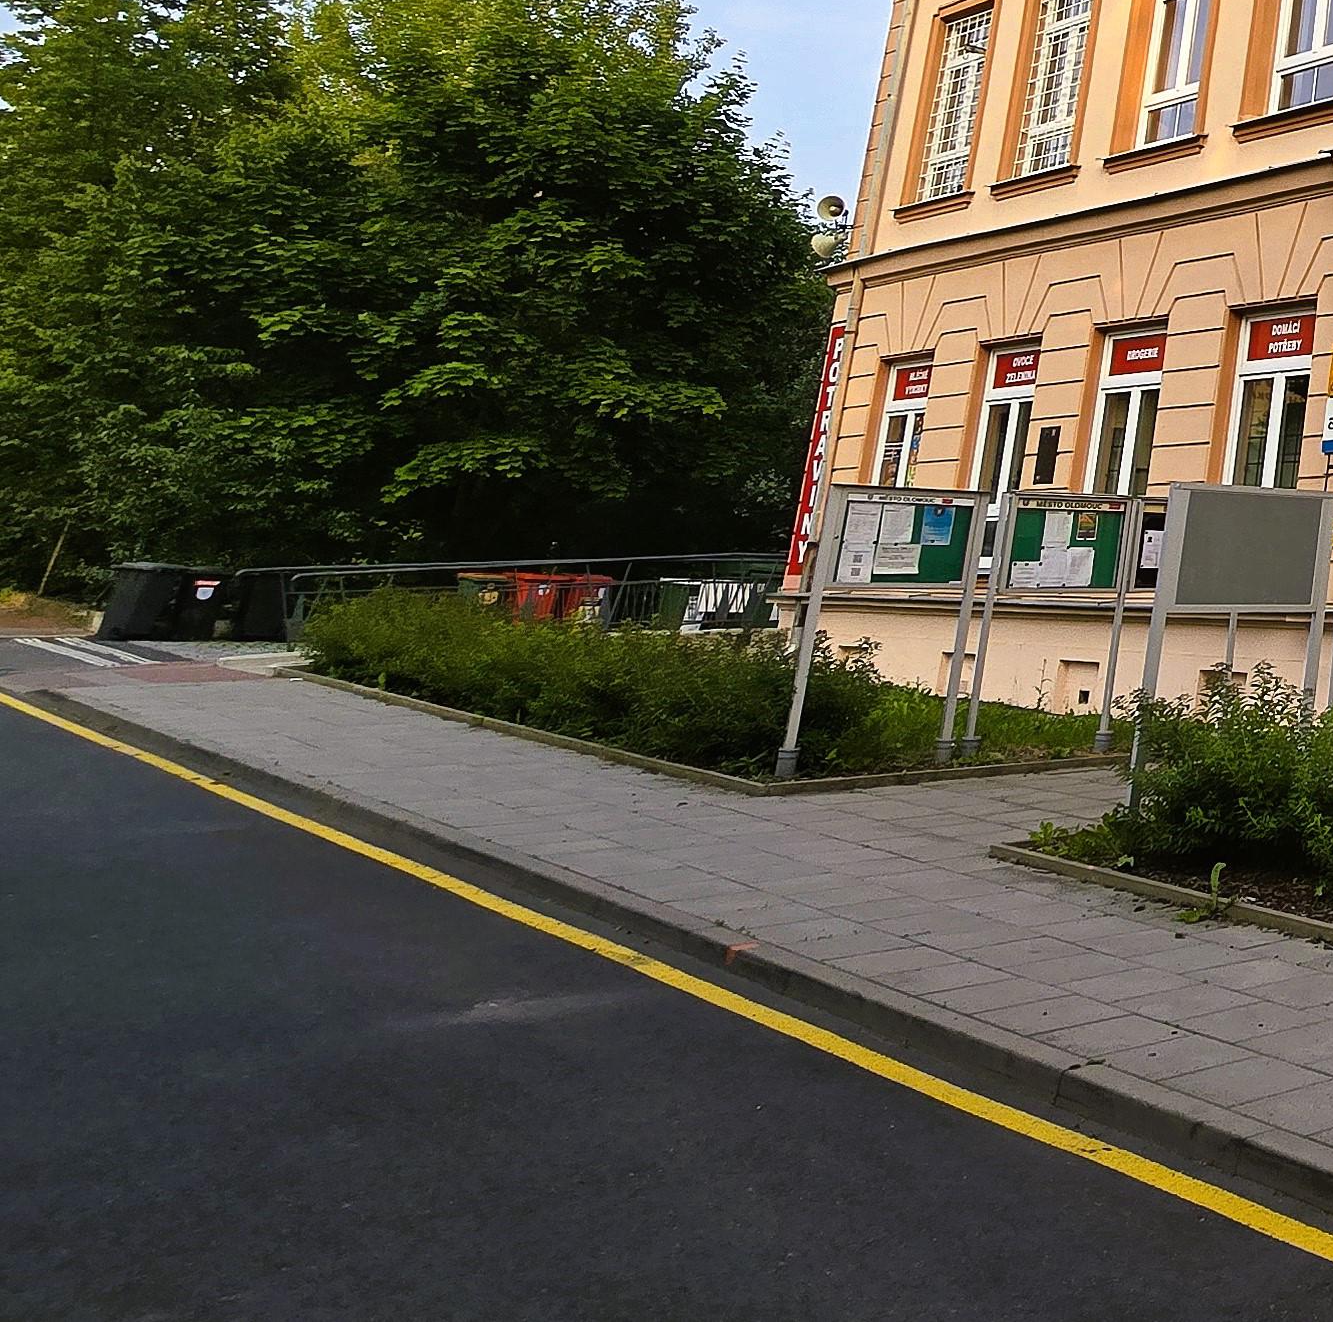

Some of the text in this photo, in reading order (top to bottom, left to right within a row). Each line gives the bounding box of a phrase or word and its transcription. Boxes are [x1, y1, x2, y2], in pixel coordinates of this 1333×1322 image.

[1272, 319, 1301, 336] DOMÁCÍ
[1267, 338, 1302, 353] POTŘEBY
[1012, 355, 1034, 367] OVOCE
[798, 338, 844, 564] POTRAVINY
[1036, 500, 1063, 508] MĚSTO
